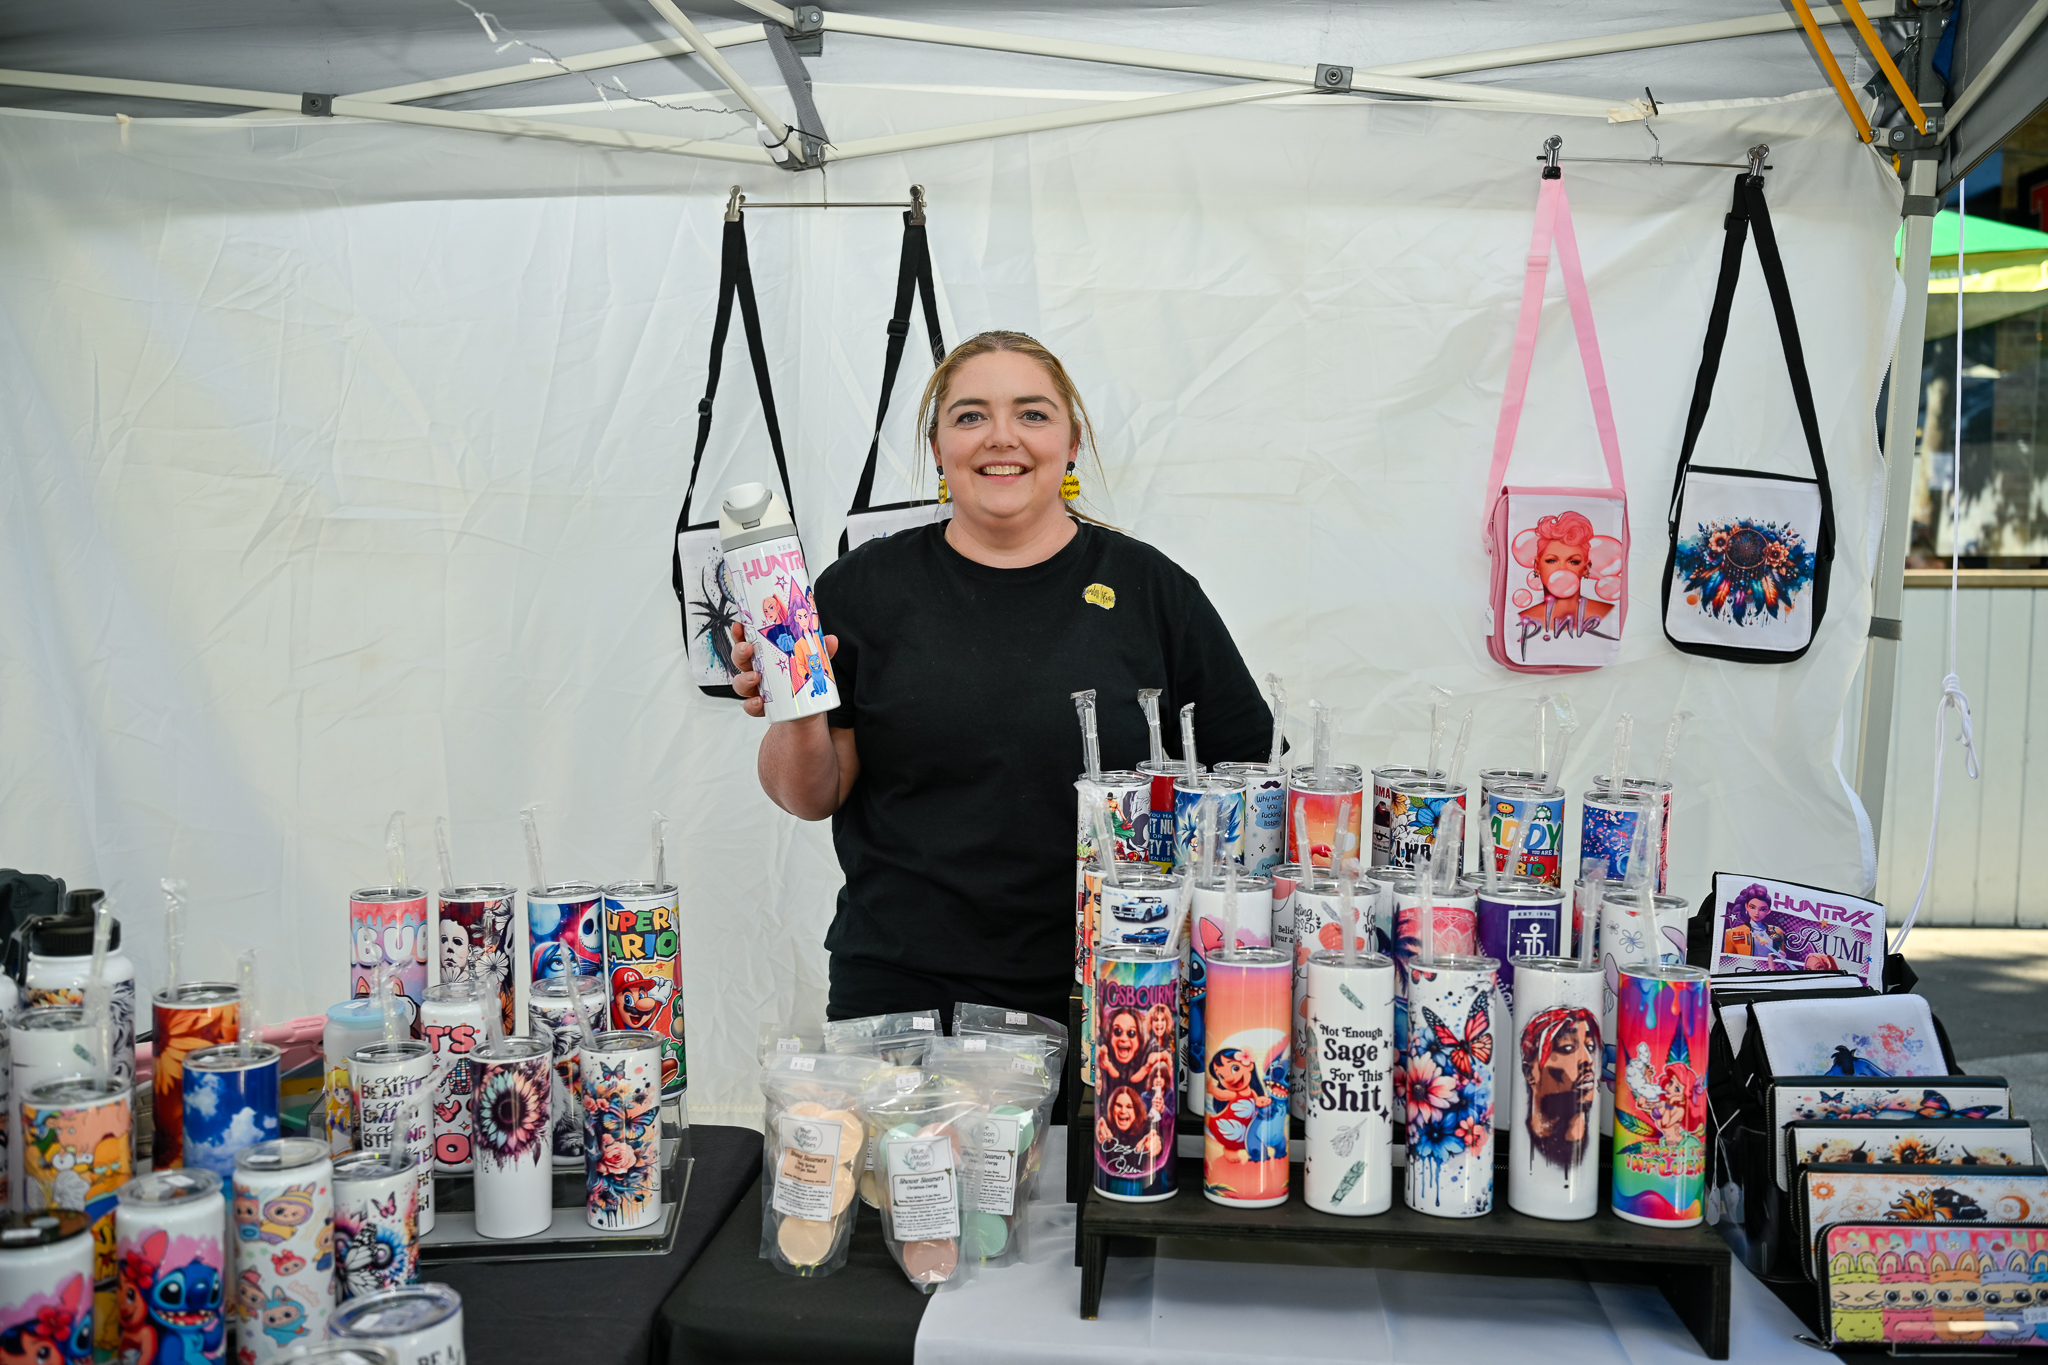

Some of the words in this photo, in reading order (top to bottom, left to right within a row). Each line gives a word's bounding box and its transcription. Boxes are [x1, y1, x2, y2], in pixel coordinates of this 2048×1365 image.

[1516, 595, 1620, 662] p!nk
[1262, 811, 1281, 819] fucking
[1274, 934, 1287, 942] your
[1785, 926, 1866, 965] RUMI
[1319, 1023, 1339, 1037] Not
[1342, 1026, 1383, 1041] Enough
[1323, 1038, 1378, 1068] Sage
[1330, 1067, 1354, 1082] For
[1358, 1069, 1383, 1082] This
[1319, 1080, 1381, 1112] Shit
